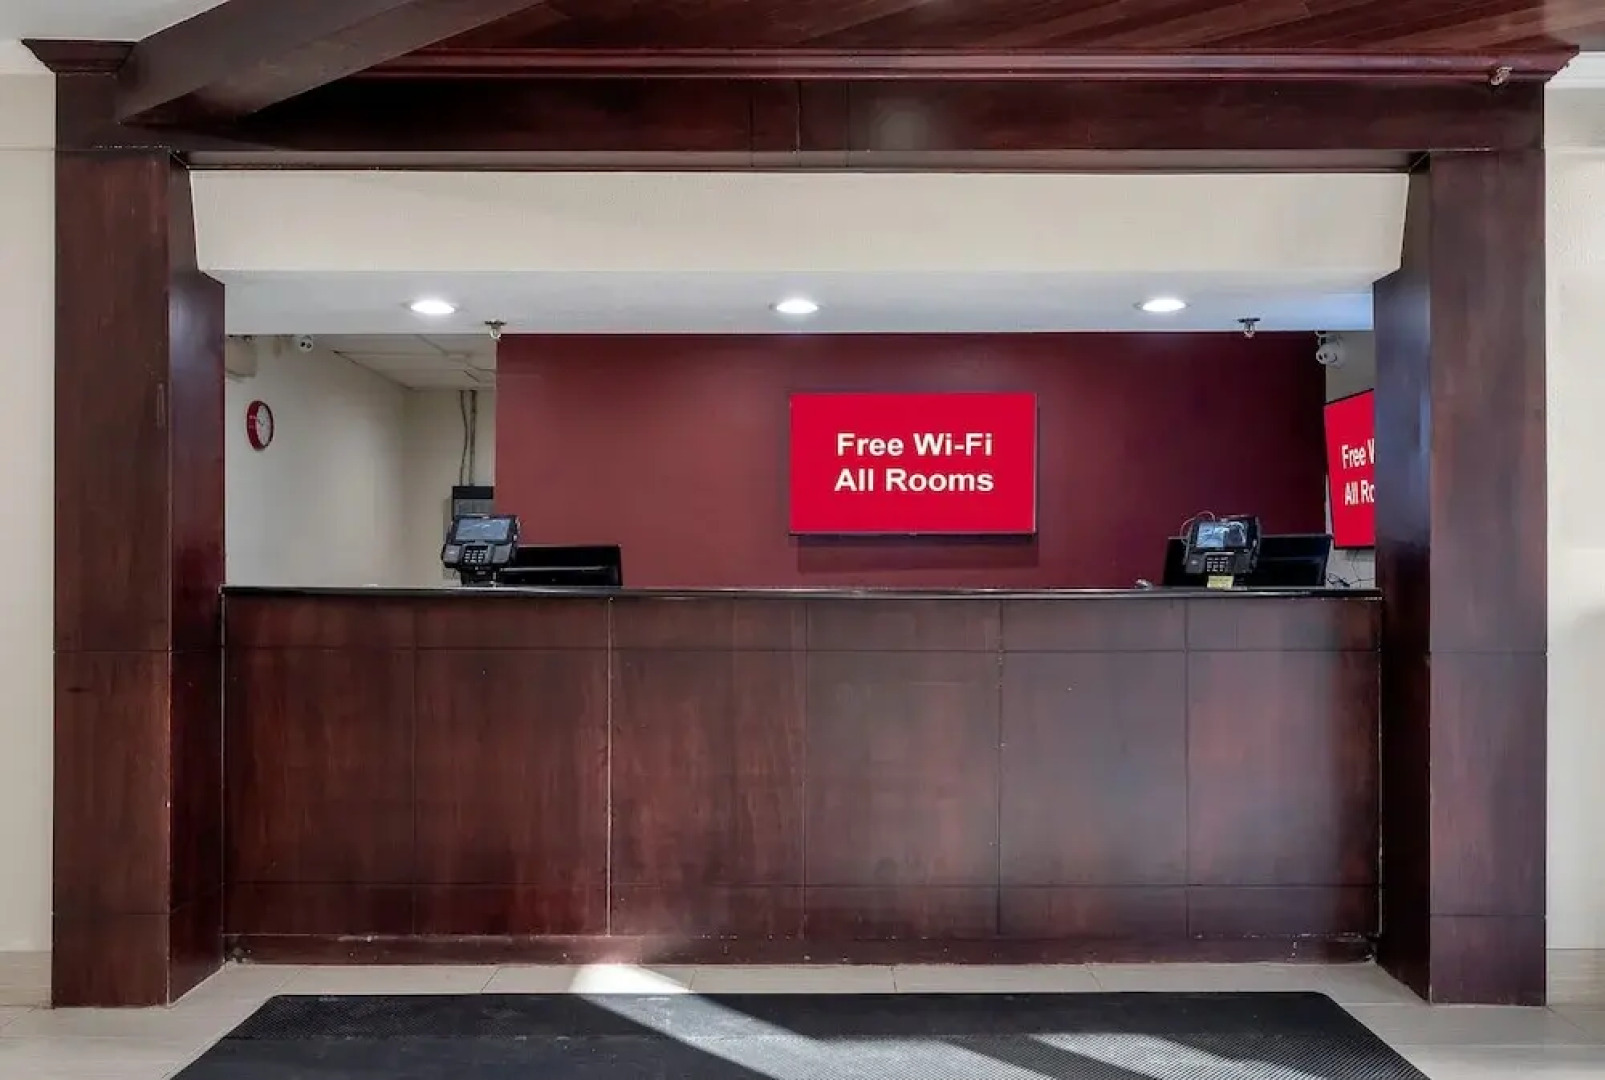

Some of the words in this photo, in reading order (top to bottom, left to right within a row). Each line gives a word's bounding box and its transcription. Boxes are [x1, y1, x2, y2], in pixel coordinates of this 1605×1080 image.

[837, 432, 904, 456] Free
[912, 432, 993, 456] Wi-Fi
[1341, 444, 1365, 469] Free
[834, 468, 874, 491] All
[885, 468, 994, 491] Rooms
[1345, 481, 1359, 506] All
